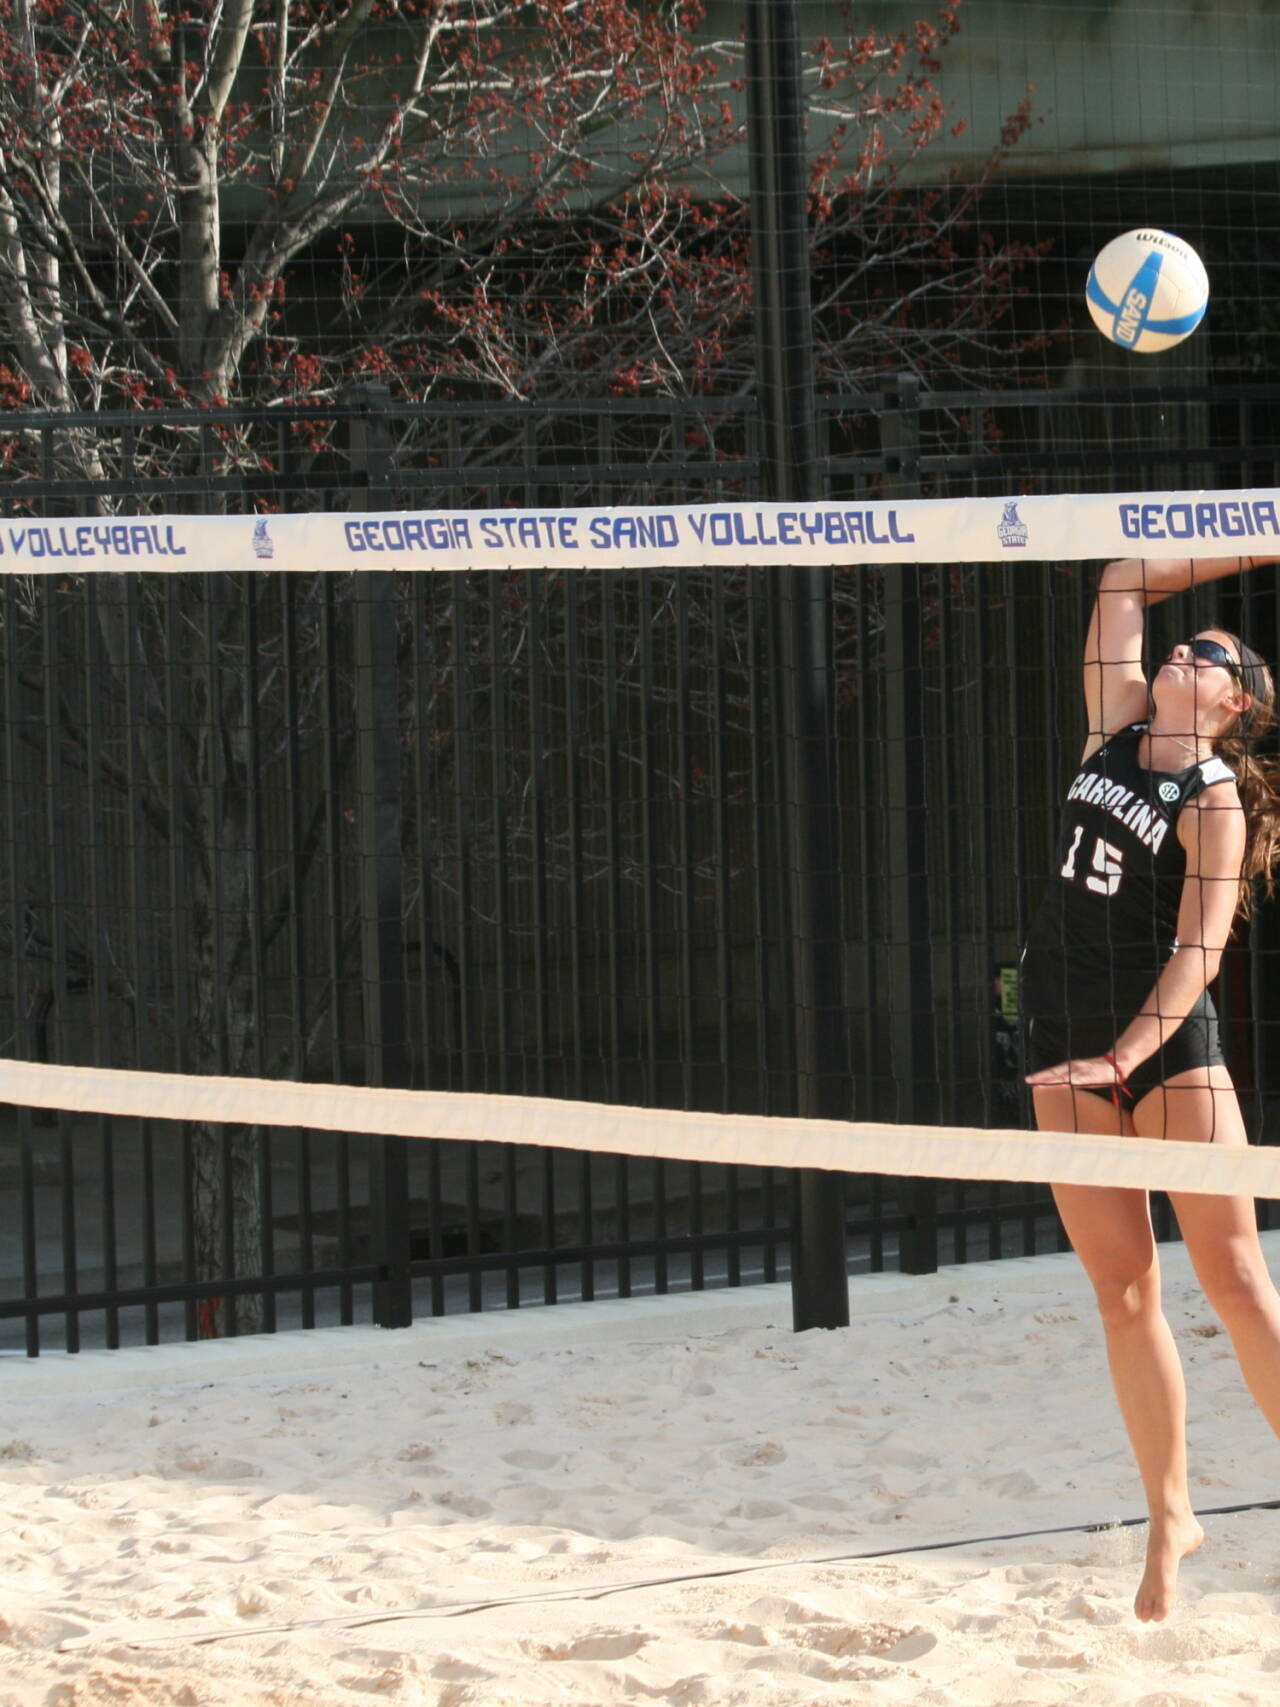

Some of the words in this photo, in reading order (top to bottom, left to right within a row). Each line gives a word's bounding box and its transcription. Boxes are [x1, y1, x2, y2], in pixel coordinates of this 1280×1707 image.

[1116, 287, 1147, 343] SAND
[344, 518, 473, 551] GEORGIA
[479, 516, 579, 548] STATE
[589, 514, 680, 549] SAND
[688, 510, 916, 547] VOLLEYBALL
[1119, 501, 1280, 539] GEORGIA
[8, 525, 187, 557] VOLLEYBALL
[1160, 782, 1180, 802] SEC
[1067, 773, 1169, 856] CAROLINA
[1061, 825, 1124, 897] 15
